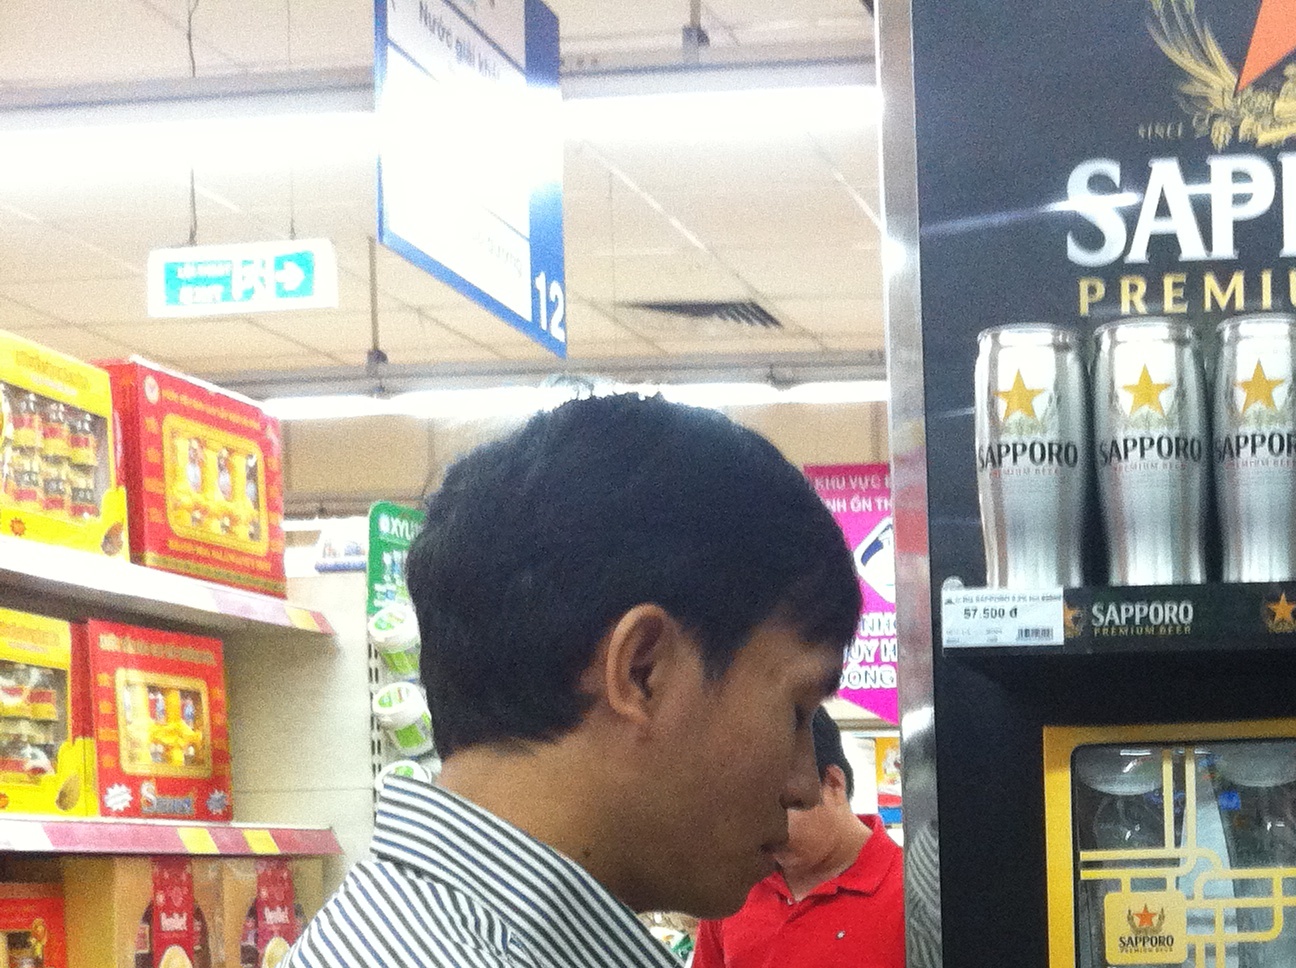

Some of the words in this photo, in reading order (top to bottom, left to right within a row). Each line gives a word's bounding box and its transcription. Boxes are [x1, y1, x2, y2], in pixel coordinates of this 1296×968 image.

[535, 270, 566, 343] 12
[979, 440, 1078, 469] SAPPORO
[1100, 435, 1200, 467] SAPPORO
[963, 607, 1005, 619] 57.500
[1092, 602, 1194, 627] SAPPORO
[1094, 627, 1155, 637] PREMIUM
[1159, 626, 1192, 635] BEER
[1119, 935, 1174, 949] SAPPORO
